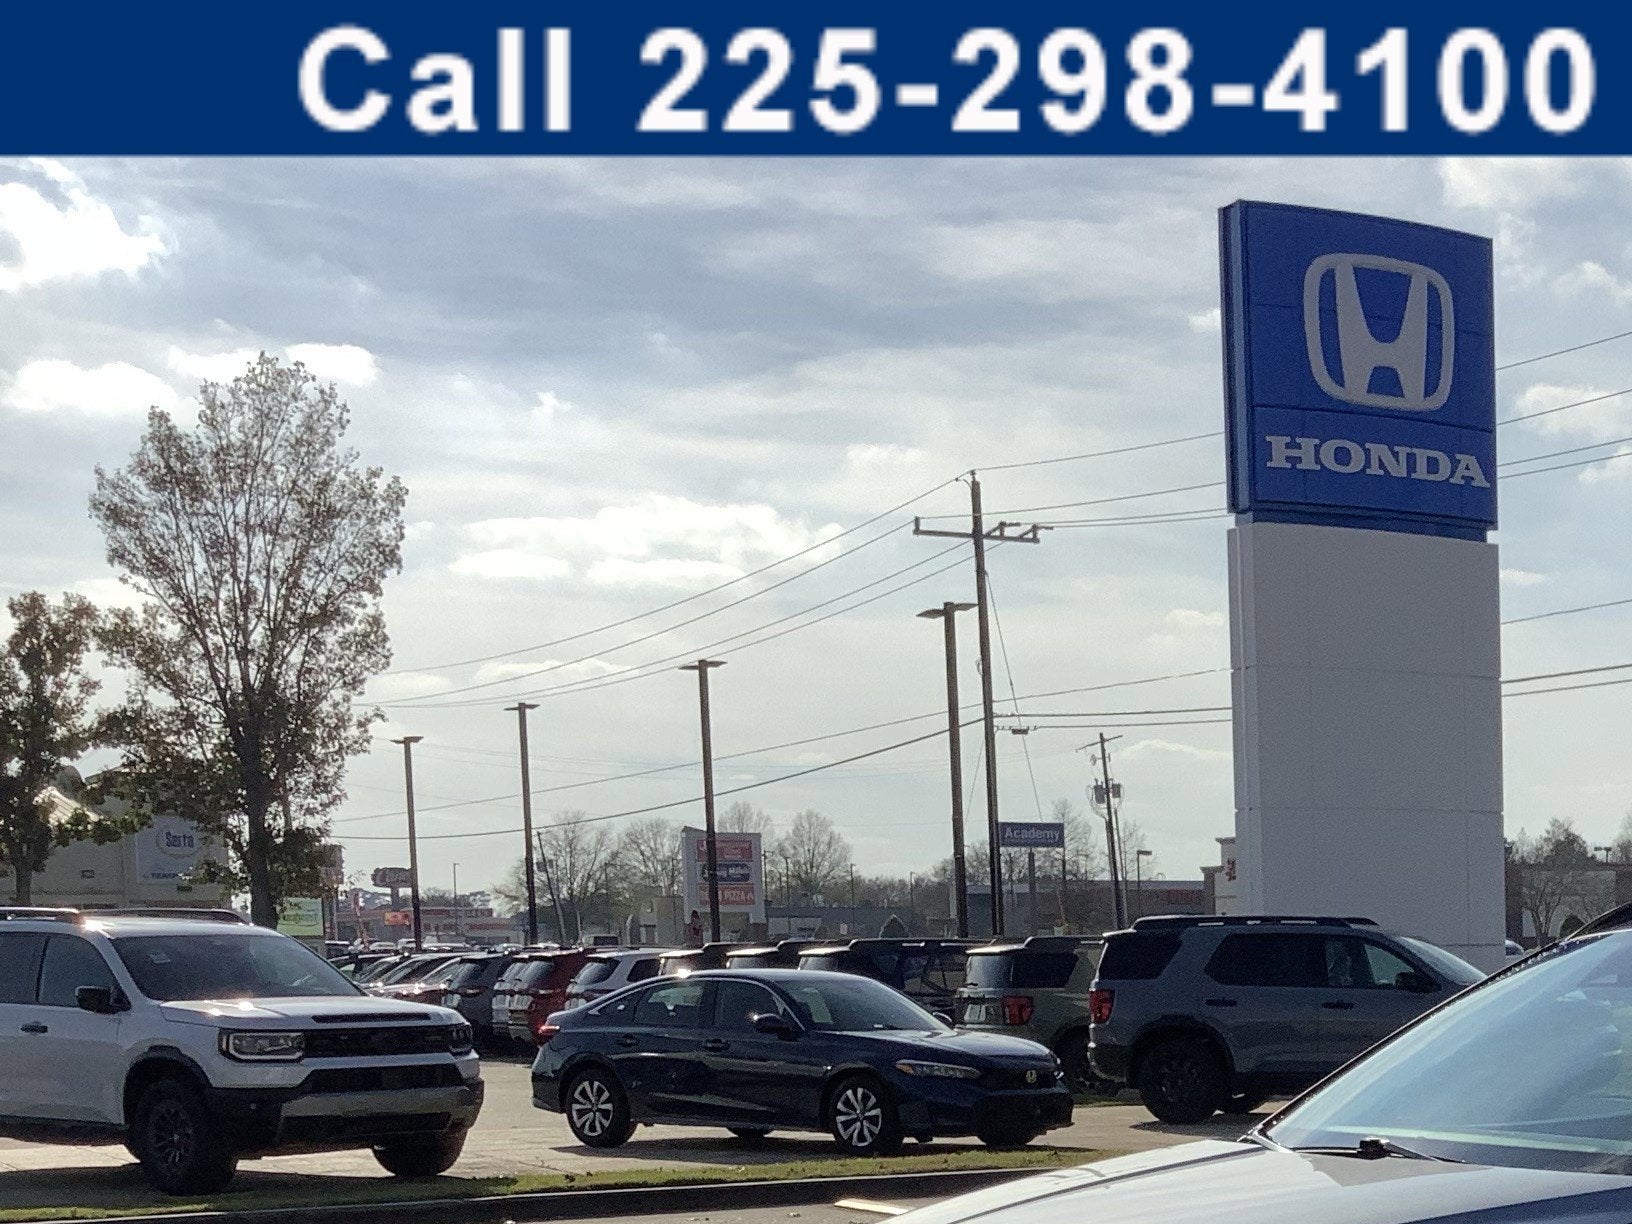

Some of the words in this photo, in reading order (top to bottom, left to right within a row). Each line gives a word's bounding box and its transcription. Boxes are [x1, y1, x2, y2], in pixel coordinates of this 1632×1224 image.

[1265, 435, 1491, 489] HONDA
[165, 829, 195, 849] Serta
[1004, 826, 1060, 843] Academy
